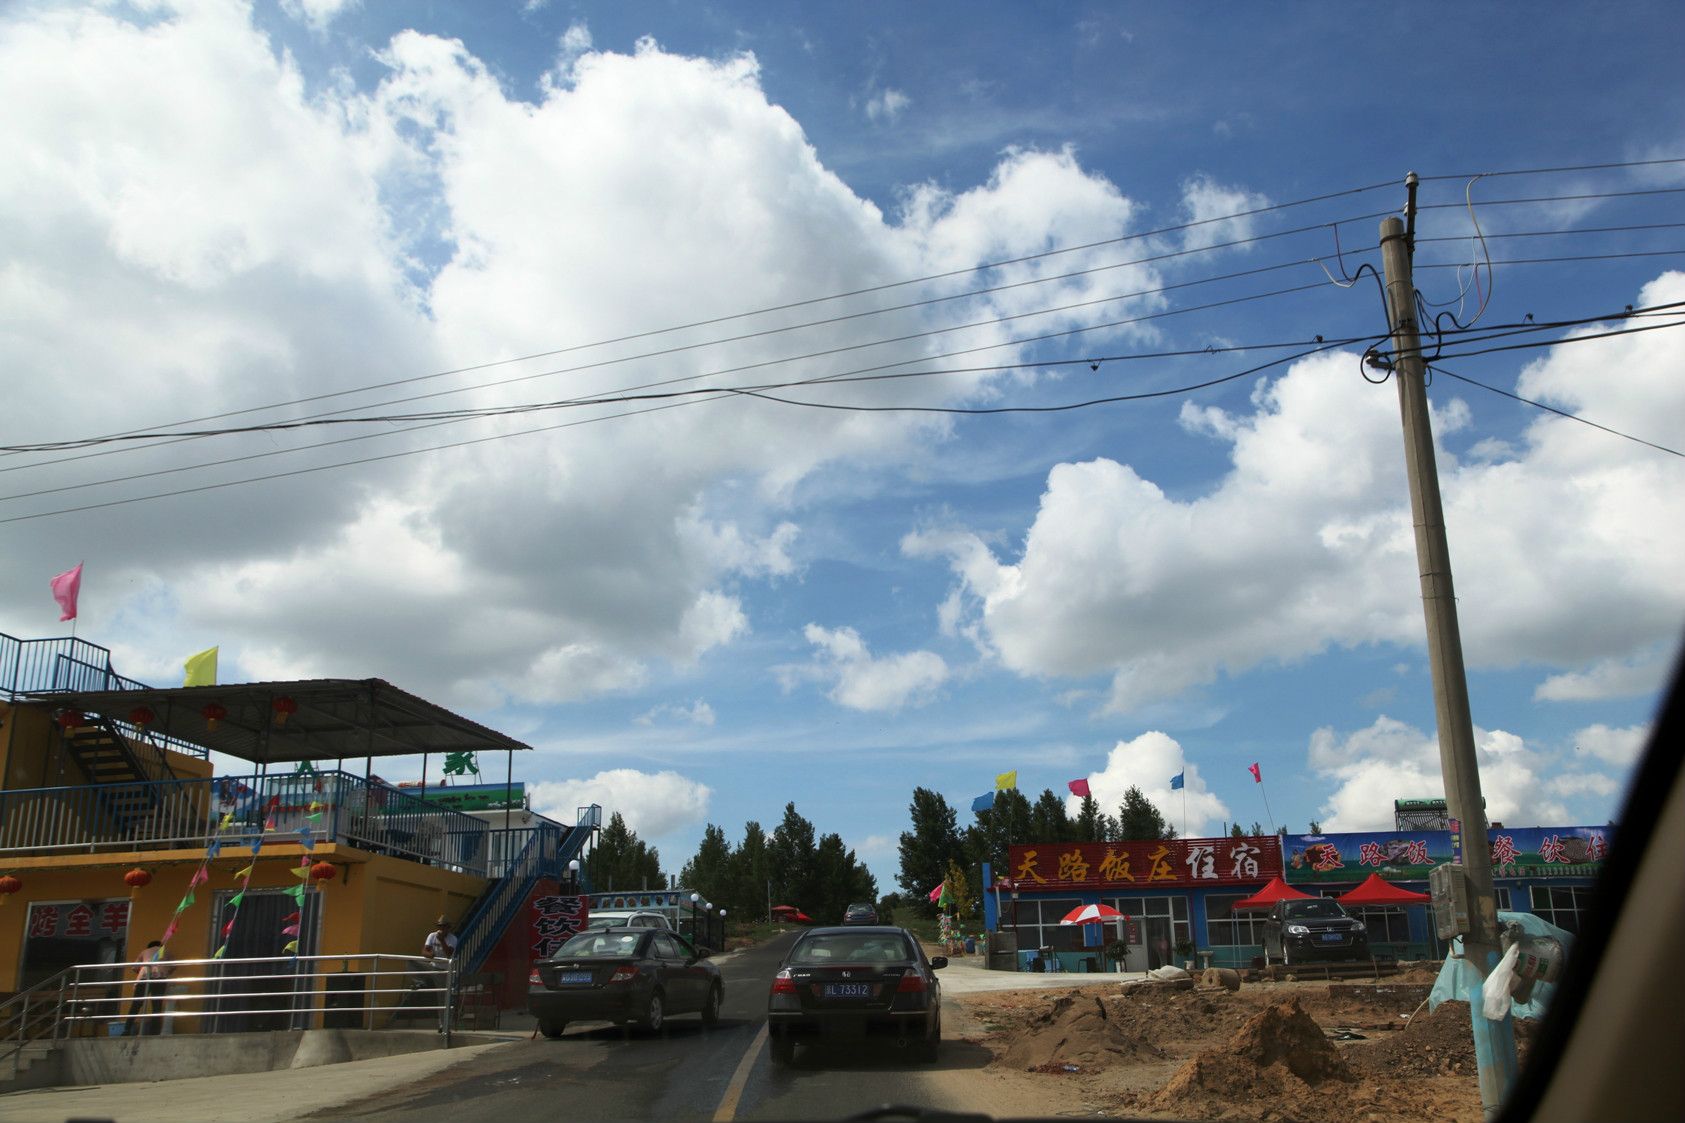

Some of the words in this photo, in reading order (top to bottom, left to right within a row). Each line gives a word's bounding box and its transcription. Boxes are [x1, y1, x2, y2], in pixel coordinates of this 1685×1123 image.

[1017, 842, 1260, 885] 天路饭庄住宿
[1317, 836, 1436, 870] 天路饭
[30, 903, 129, 938] 烤全羊
